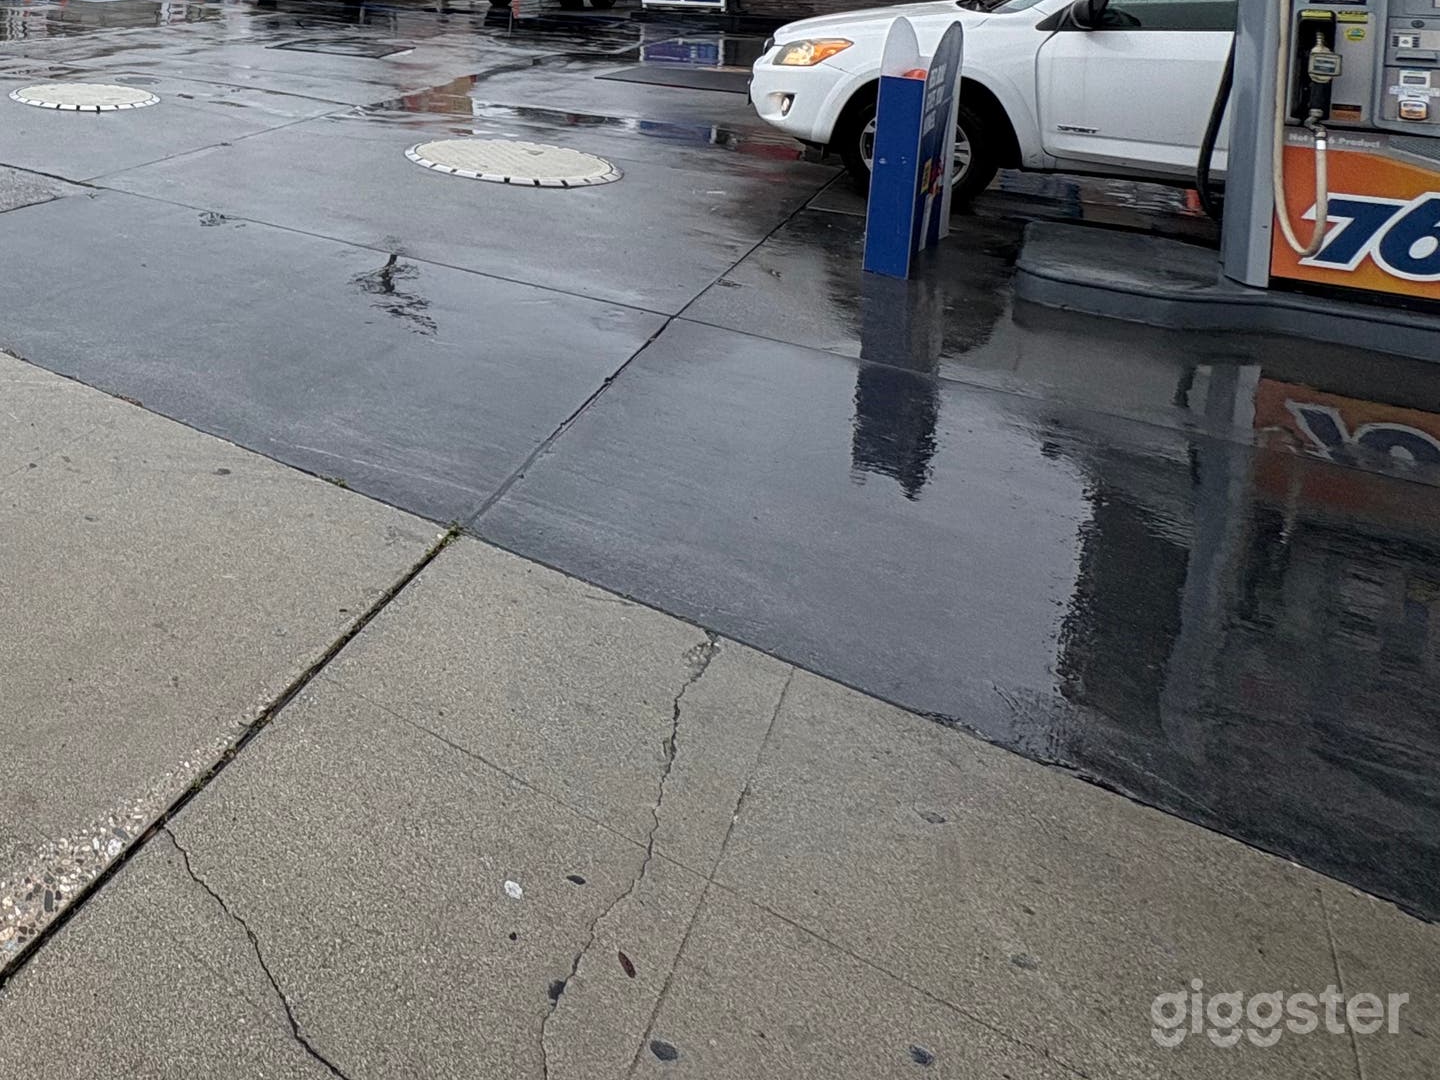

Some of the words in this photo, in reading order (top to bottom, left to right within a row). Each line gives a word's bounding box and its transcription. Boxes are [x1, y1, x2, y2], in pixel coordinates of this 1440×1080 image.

[1289, 133, 1308, 141] Not
[1339, 137, 1380, 148] Product
[1298, 191, 1440, 281] 76
